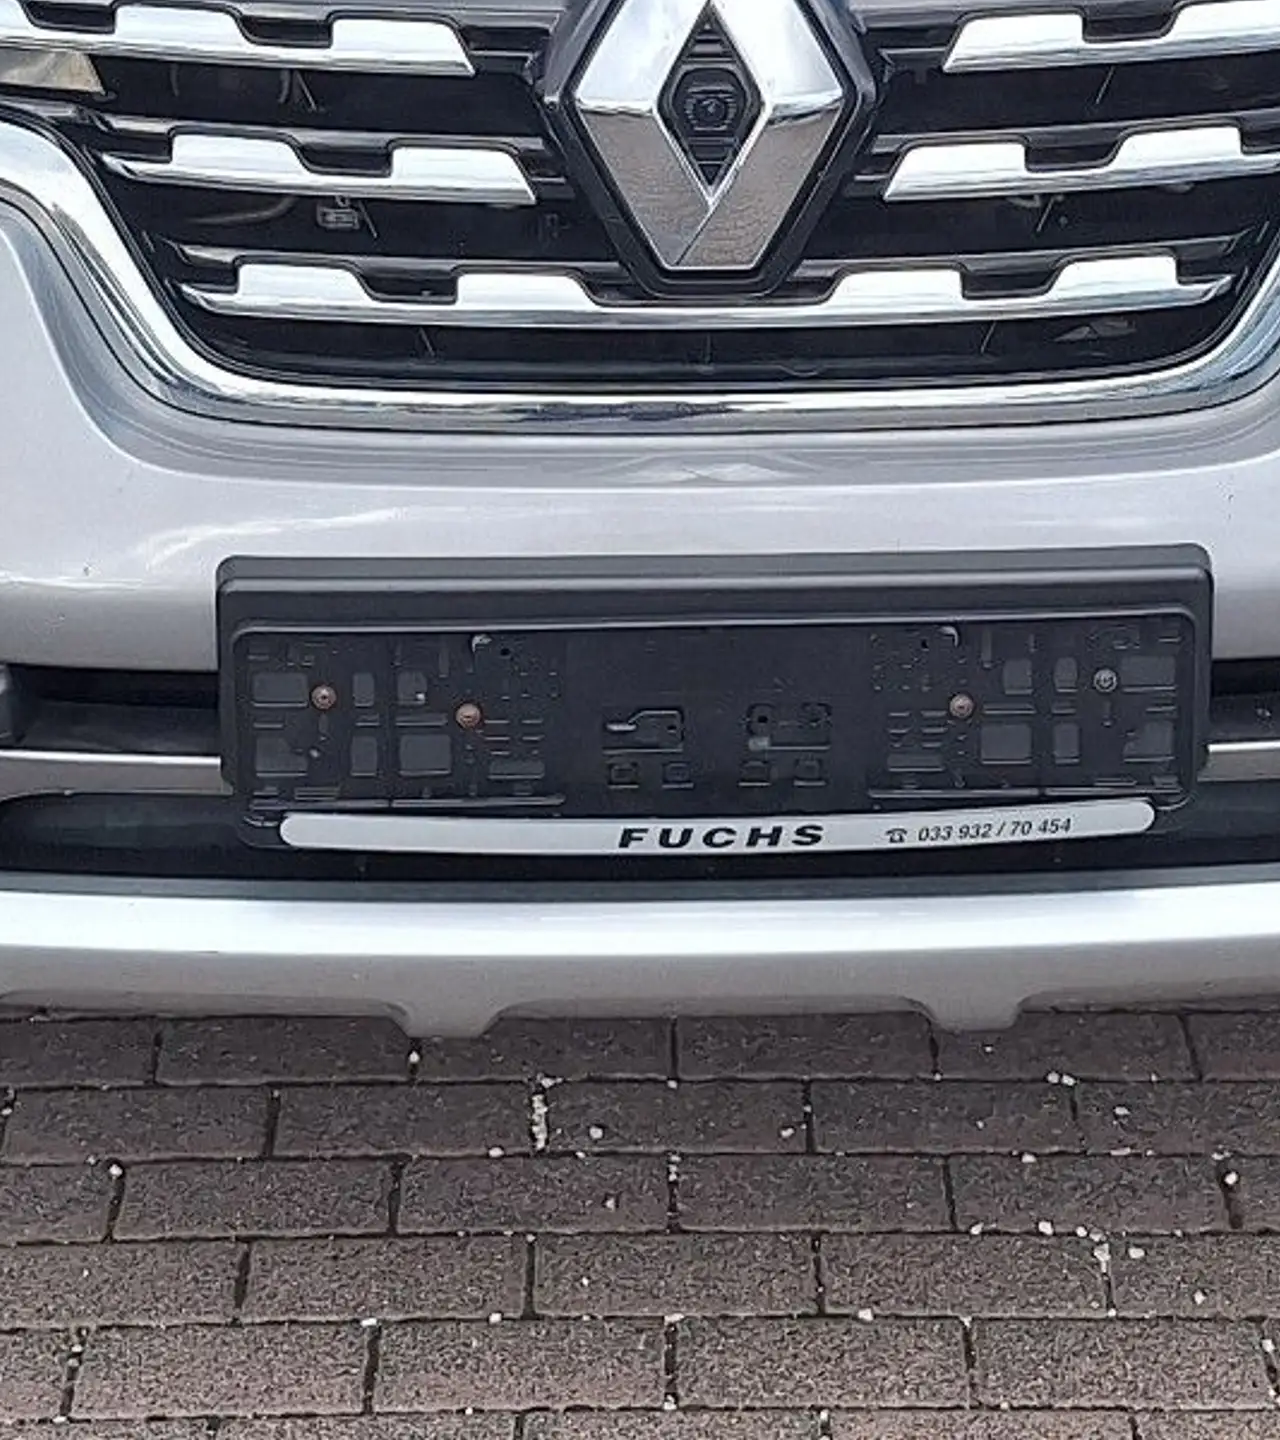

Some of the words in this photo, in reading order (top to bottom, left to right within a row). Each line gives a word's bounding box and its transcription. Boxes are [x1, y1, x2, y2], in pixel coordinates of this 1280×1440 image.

[618, 824, 824, 849] FUCHS
[918, 825, 954, 841] 033
[958, 823, 993, 839] 932
[1010, 820, 1032, 836] 70
[1037, 817, 1072, 834] 454
